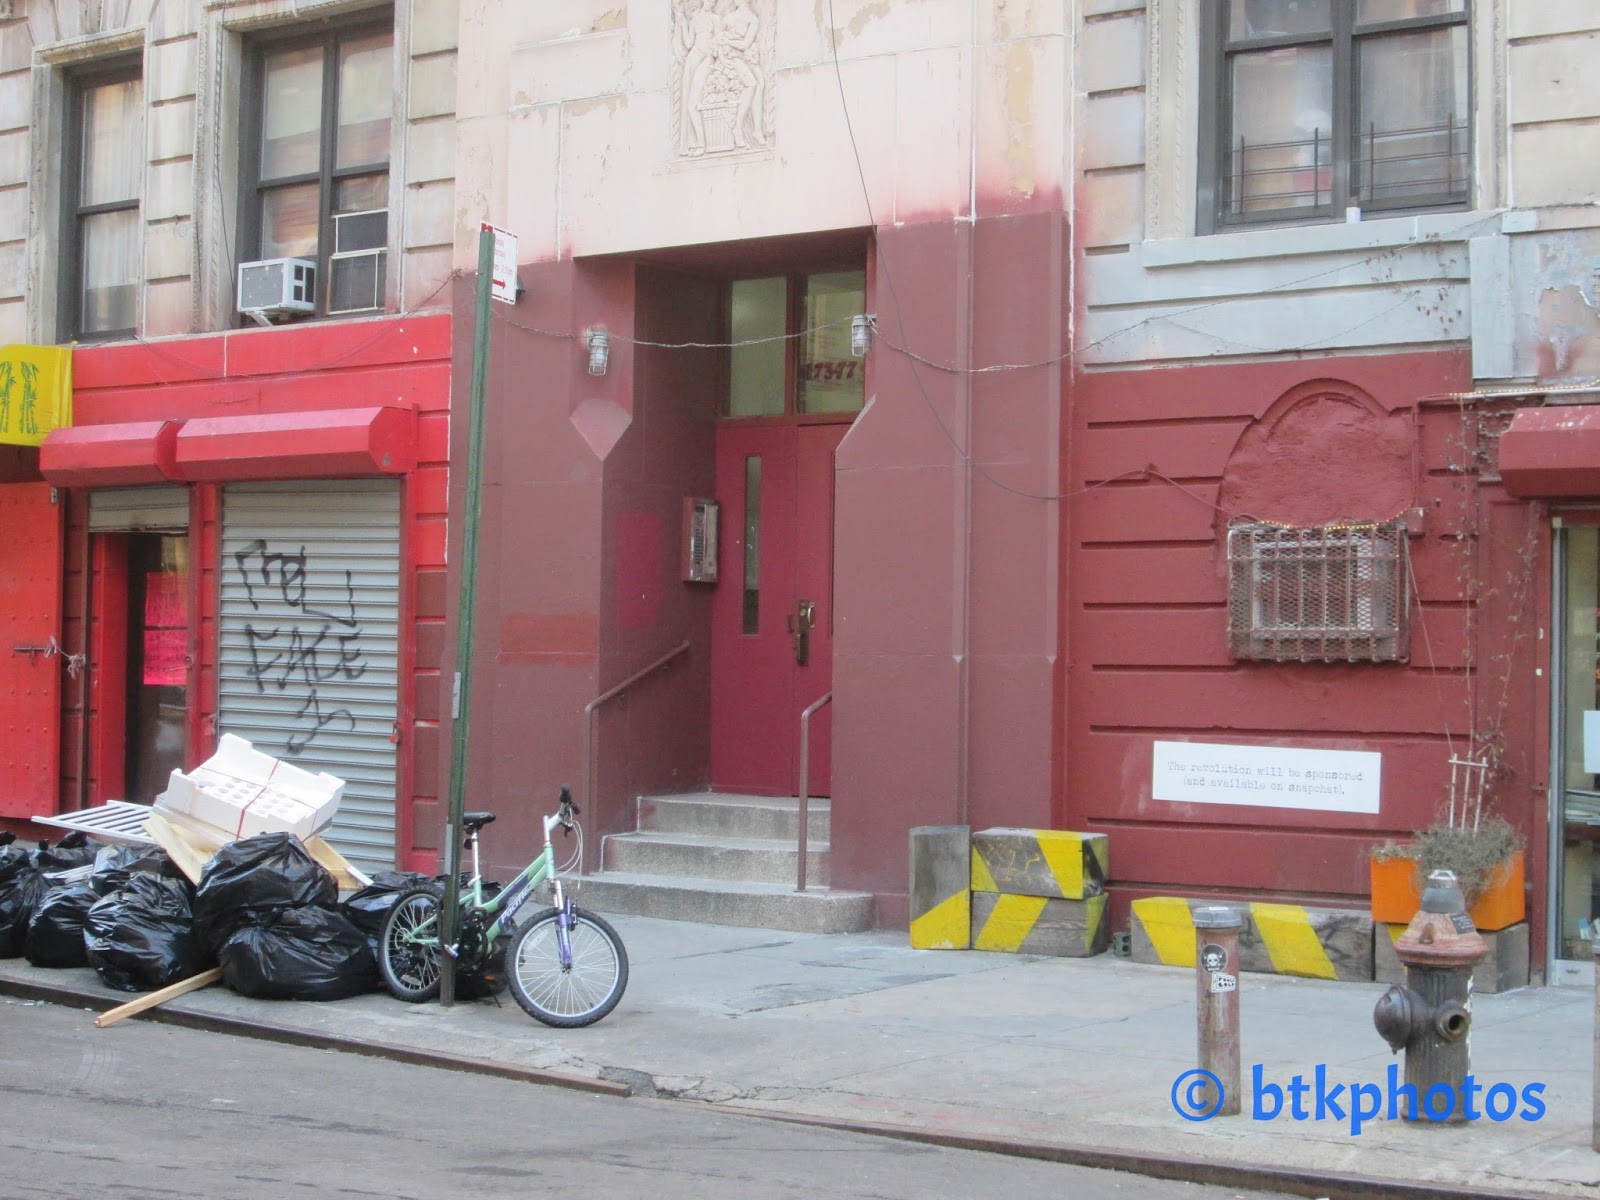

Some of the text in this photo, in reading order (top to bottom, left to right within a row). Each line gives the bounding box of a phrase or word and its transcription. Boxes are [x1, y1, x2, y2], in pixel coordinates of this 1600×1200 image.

[1167, 761, 1363, 781] The revolution will be sponsored
[1210, 778, 1266, 790] available
[1270, 782, 1284, 791] on
